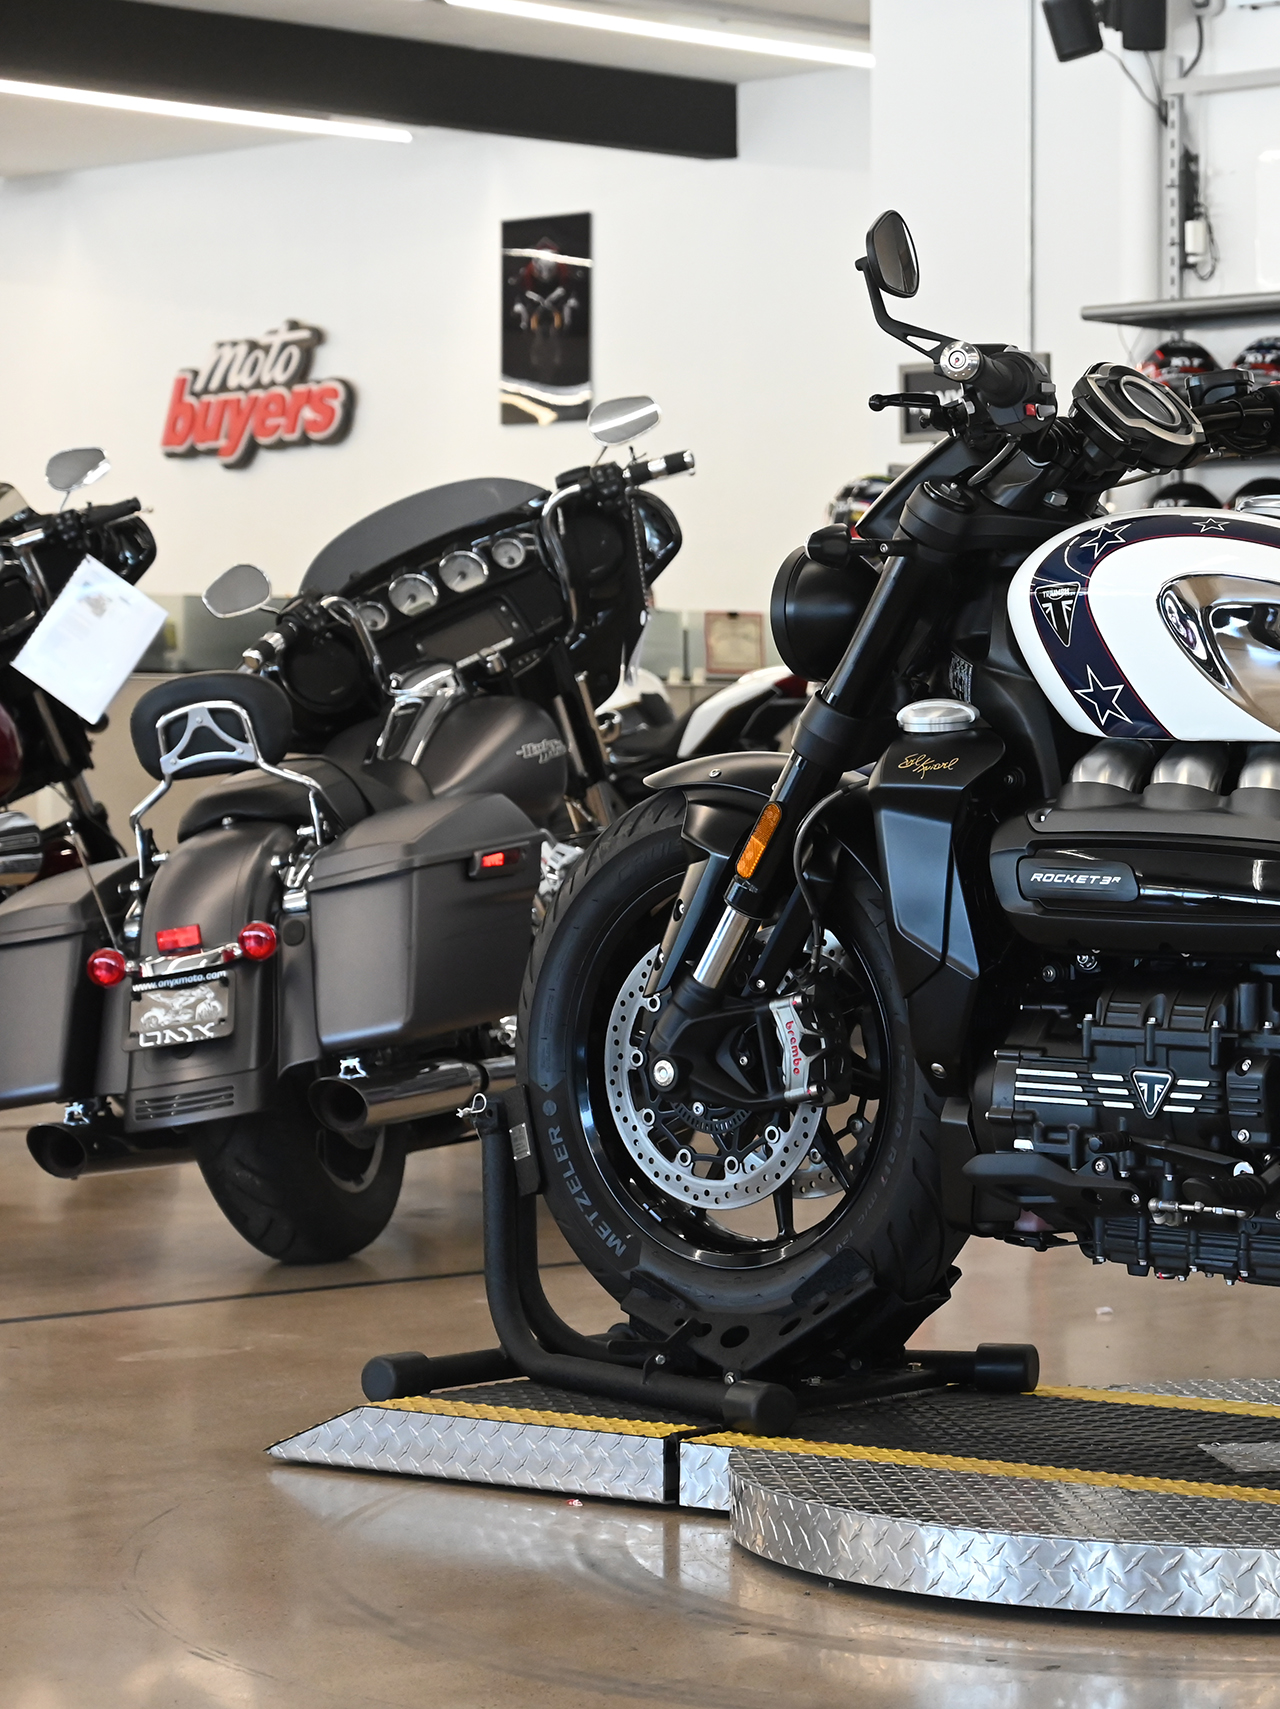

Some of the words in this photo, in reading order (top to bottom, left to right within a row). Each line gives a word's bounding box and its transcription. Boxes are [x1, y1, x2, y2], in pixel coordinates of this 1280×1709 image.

[161, 374, 339, 459] buyers
[131, 970, 228, 993] www.onyxmoto.com
[138, 1021, 216, 1048] ONYX
[785, 1020, 803, 1076] brembo
[547, 1124, 628, 1258] METZELER
